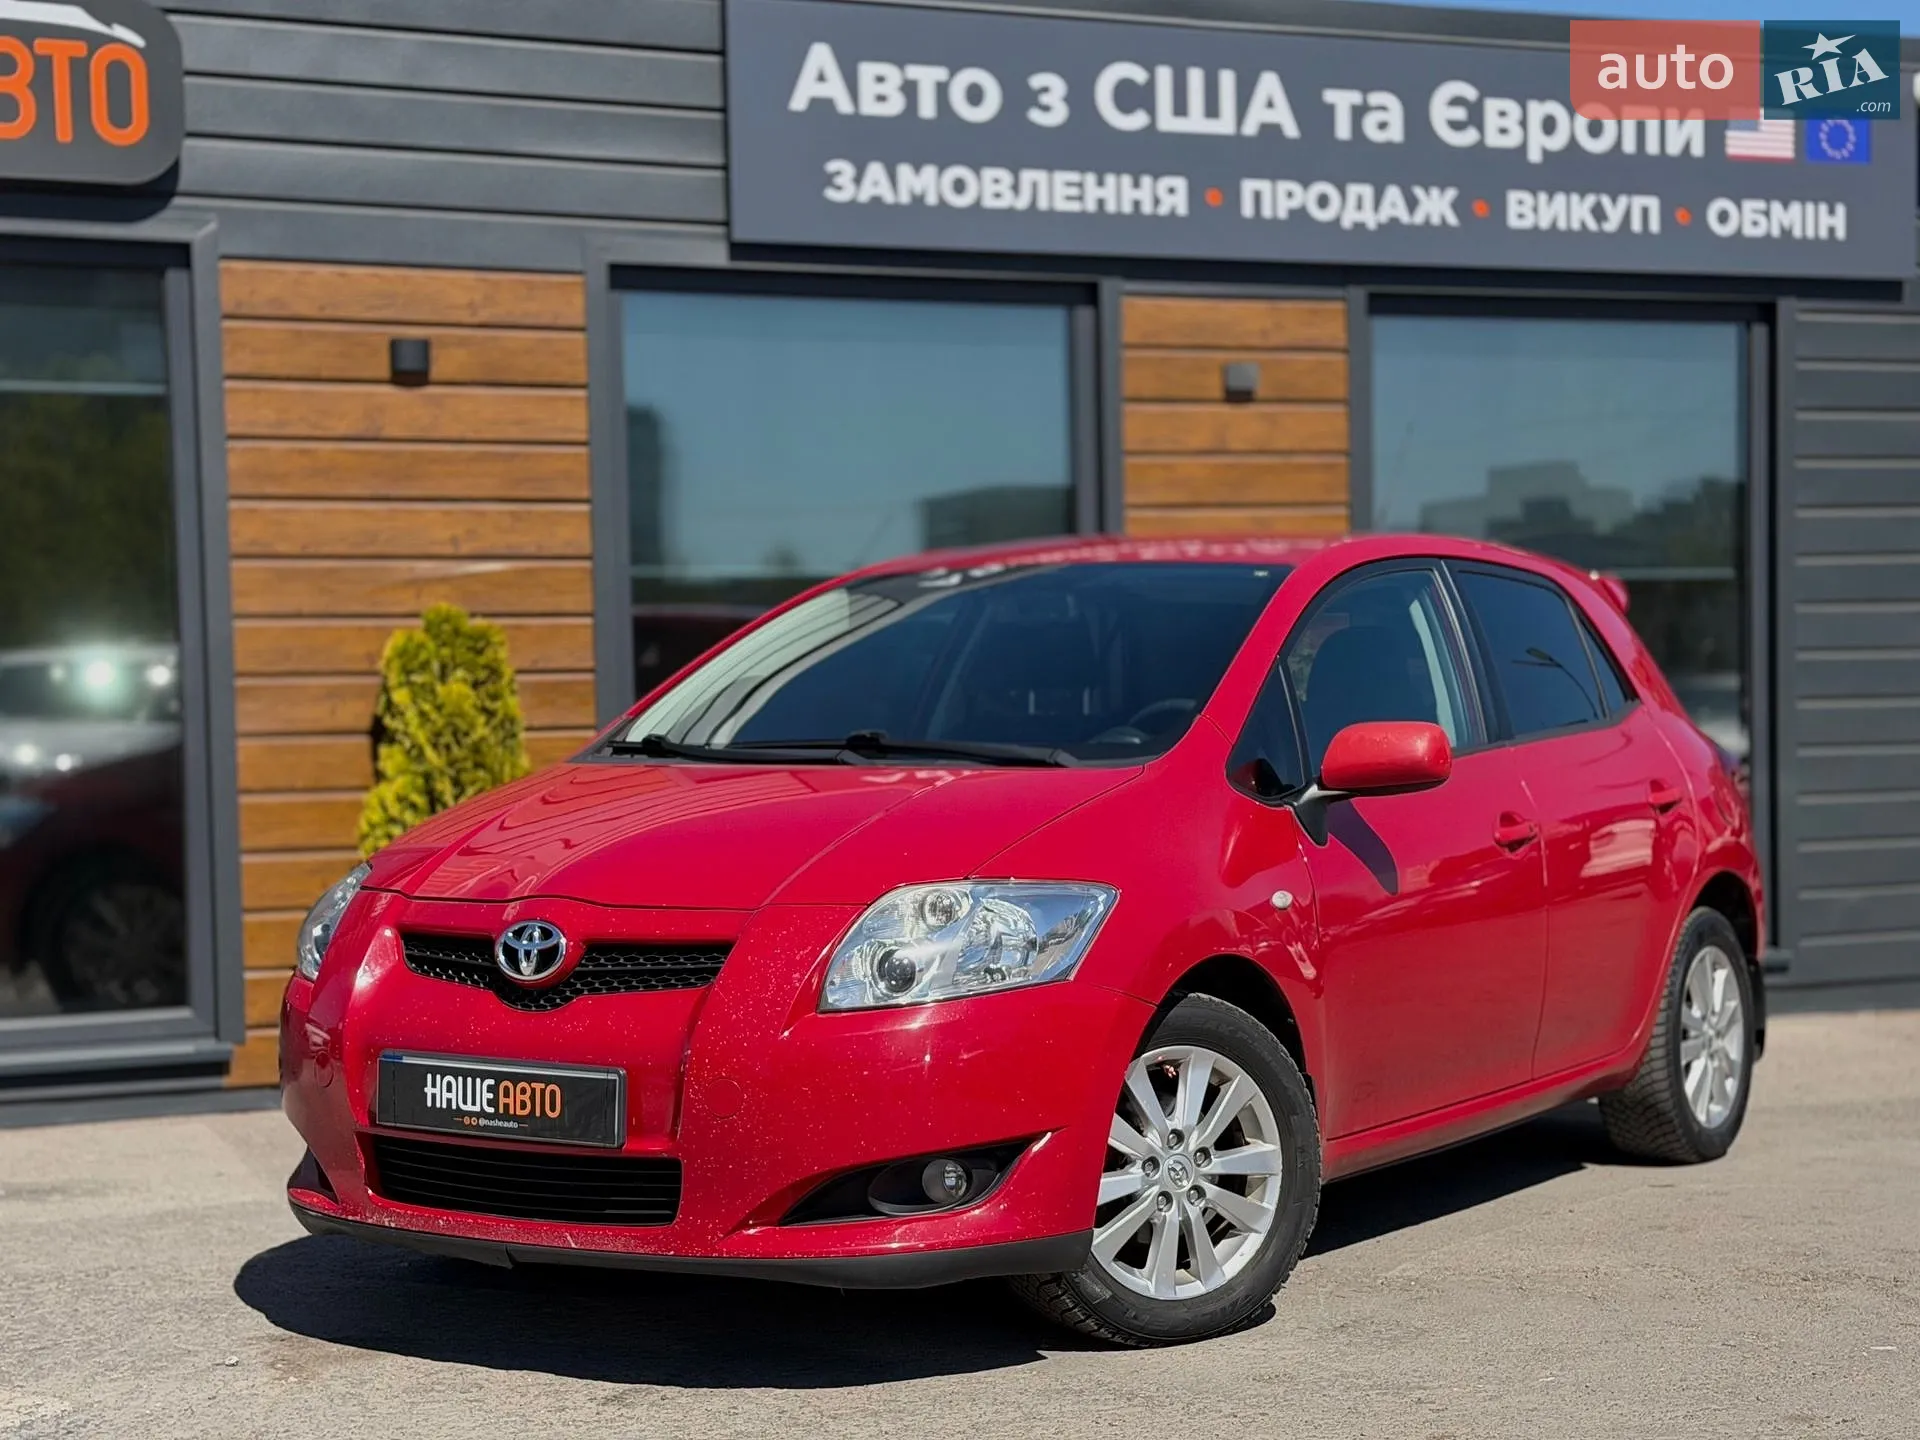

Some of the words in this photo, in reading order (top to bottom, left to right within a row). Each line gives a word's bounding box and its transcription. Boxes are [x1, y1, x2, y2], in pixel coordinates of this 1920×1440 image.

[788, 41, 1003, 123] Авто
[1026, 71, 1070, 128] з
[1094, 61, 1302, 139] США
[1322, 88, 1405, 144] та
[1428, 80, 1706, 163] Європи
[823, 159, 1190, 217] ЗАМОВЛЕННЯ
[1240, 178, 1460, 230] ПРОДАЖ
[1506, 190, 1661, 235] ВИКУП
[1706, 198, 1847, 241] ОБМІН
